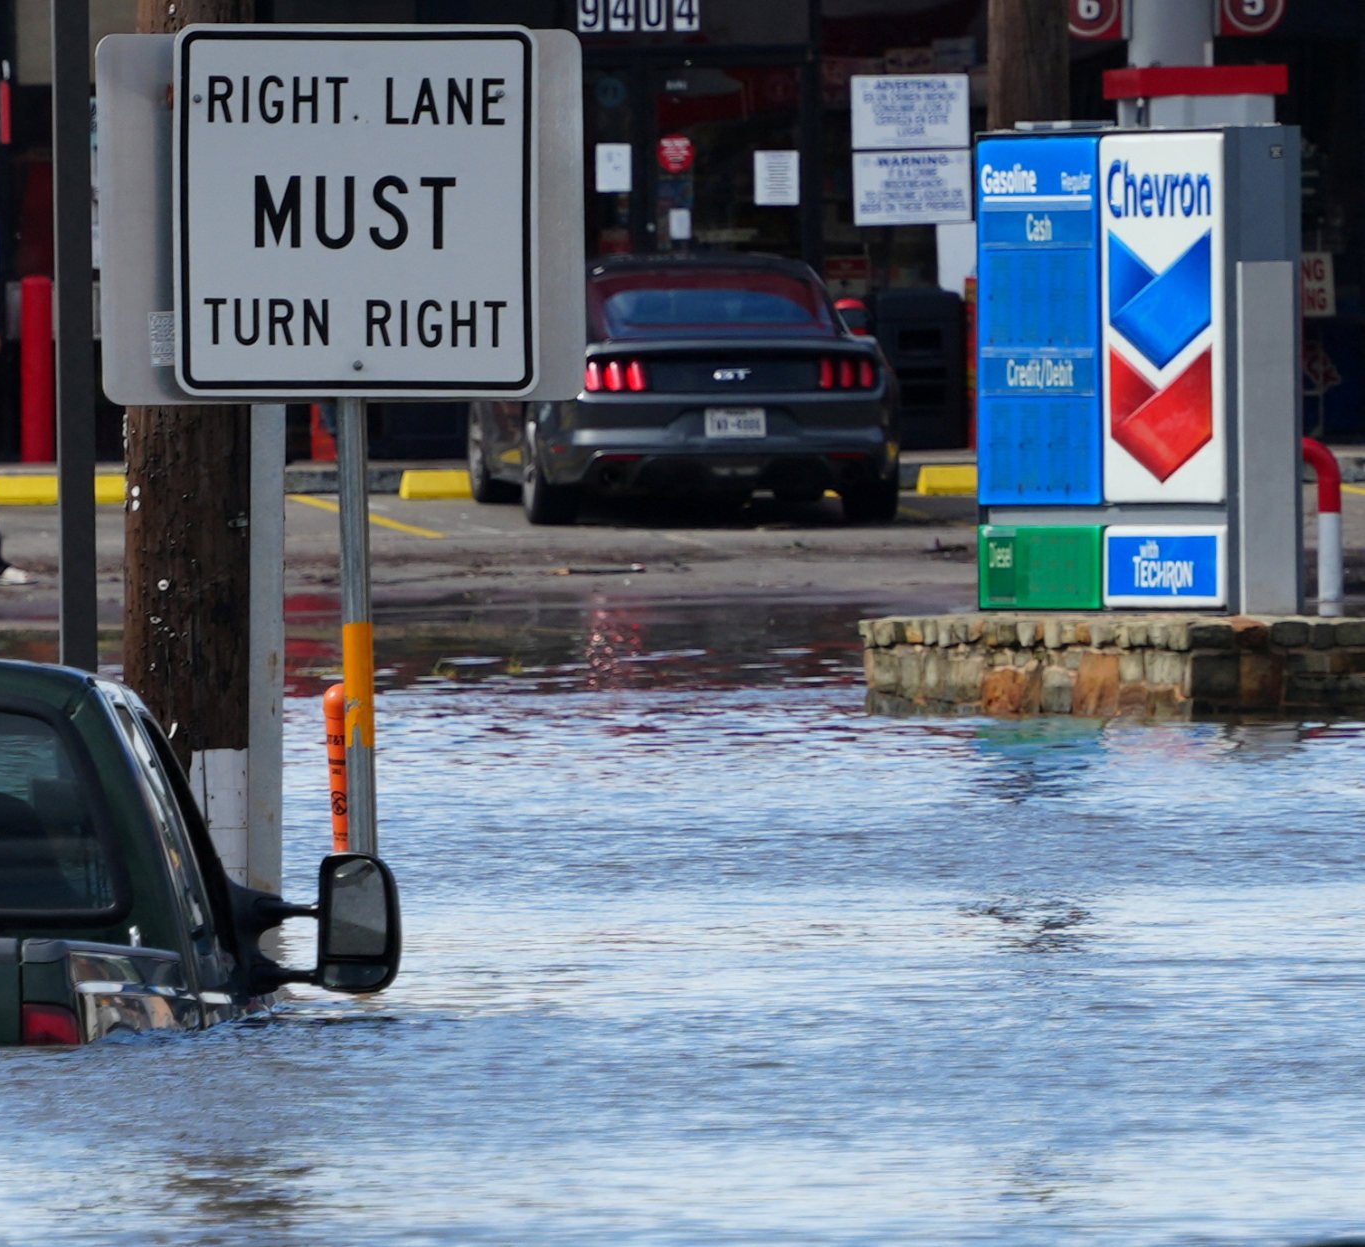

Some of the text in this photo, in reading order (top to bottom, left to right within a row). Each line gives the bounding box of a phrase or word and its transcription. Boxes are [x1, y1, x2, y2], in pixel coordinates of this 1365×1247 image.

[207, 75, 506, 125] RIGHT LANE
[877, 154, 950, 167] WARNING
[981, 164, 1037, 194] Gasoline
[1108, 160, 1212, 218] Chevron
[254, 175, 457, 250] MUST
[1026, 214, 1052, 241] Cash
[204, 298, 330, 346] TURN
[366, 300, 507, 348] RIGHT
[1006, 358, 1074, 388] Credit/Debit
[1139, 539, 1160, 558] with
[1132, 556, 1194, 595] TECHRON
